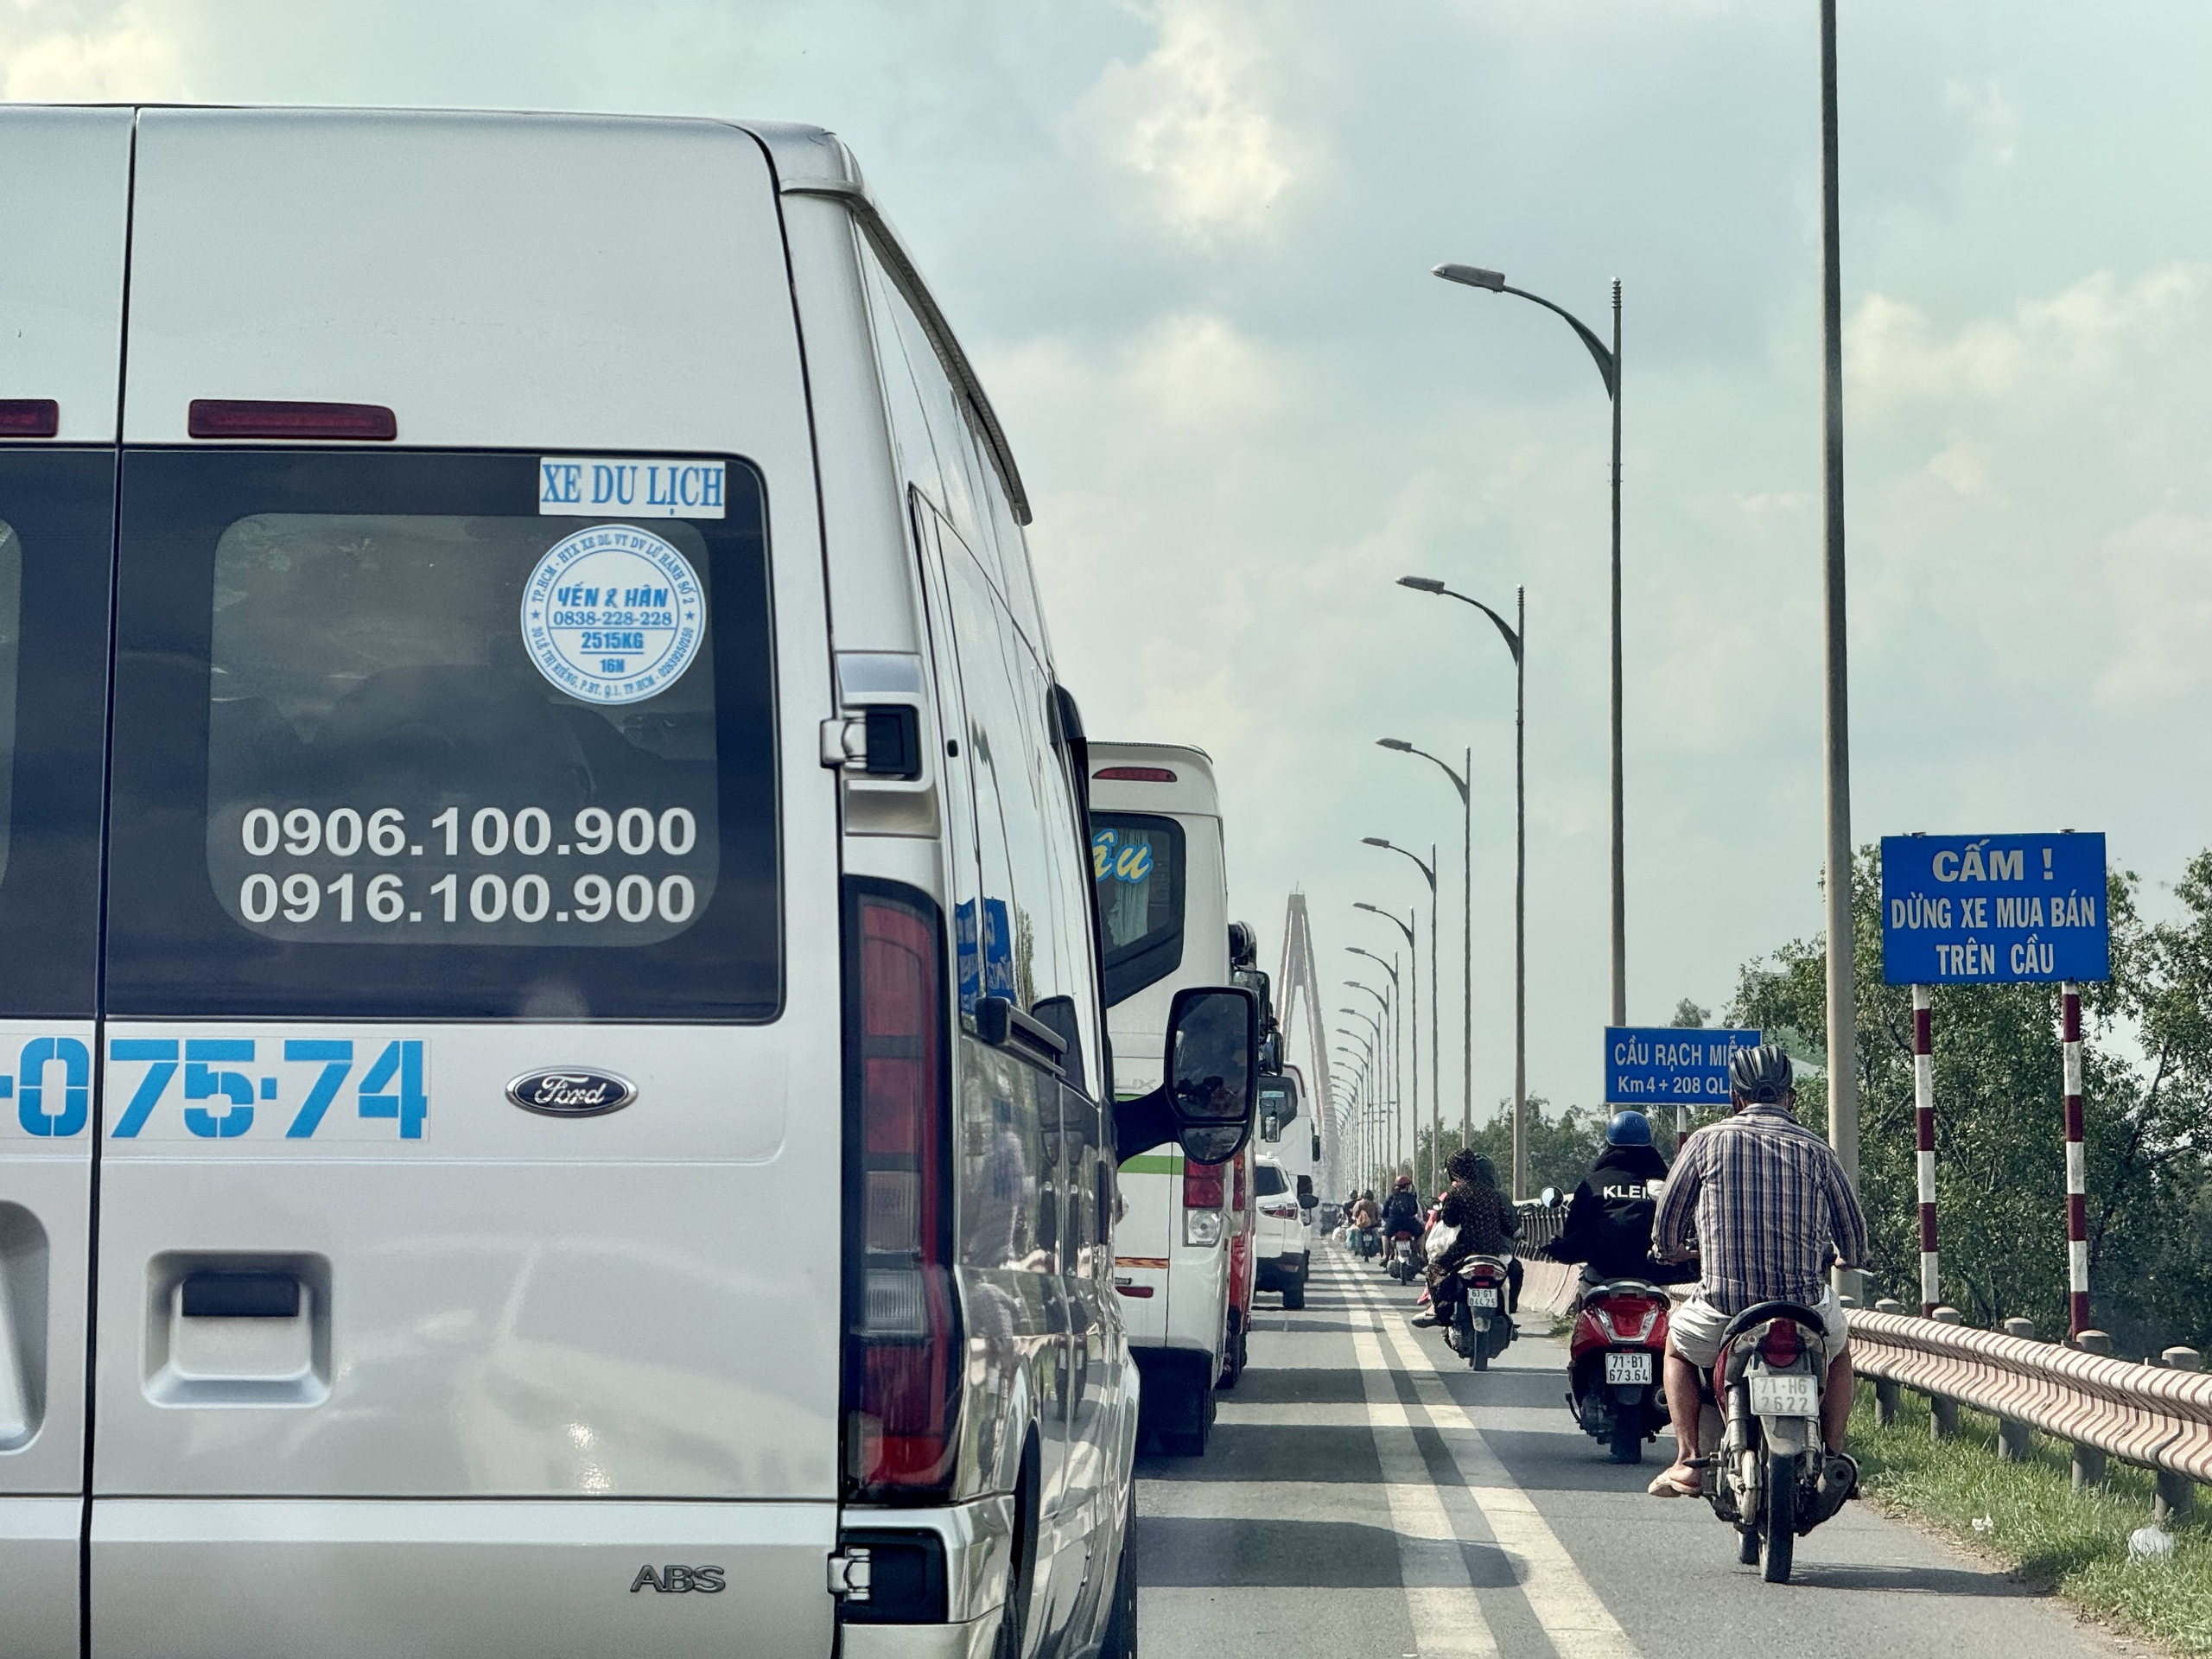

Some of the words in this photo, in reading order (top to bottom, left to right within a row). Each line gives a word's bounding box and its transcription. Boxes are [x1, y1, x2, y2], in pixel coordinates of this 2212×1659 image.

[541, 464, 582, 503] XE
[591, 465, 638, 505] DU
[646, 467, 723, 516] LỊCH
[531, 564, 557, 602] TP.HCM
[557, 543, 581, 563] HTX
[580, 537, 595, 550] XE
[614, 534, 629, 546] VT
[630, 537, 647, 550] DV
[658, 553, 685, 581] HÀNH
[677, 581, 696, 594] SỐ
[558, 582, 600, 607] YẾN
[604, 588, 618, 608] &
[625, 584, 668, 607] HÂN
[554, 611, 672, 626] 0838-228-228
[582, 632, 644, 649] 2515KG
[241, 807, 696, 856] 0906.100.900
[1932, 839, 2024, 882] CẤM
[2042, 848, 2054, 880] !
[239, 874, 696, 923] 0916.100.900
[1891, 891, 1952, 929] DỪNG
[1961, 897, 1987, 928] XE
[1996, 897, 2044, 928] MUA
[2050, 889, 2095, 927] BÁN
[1936, 937, 1995, 976] TRÊN
[2011, 933, 2054, 975] CẦU
[1614, 1034, 1649, 1065] CẦU
[1655, 1042, 1702, 1071] RẠCH
[534, 1075, 607, 1105] Ford
[1673, 1077, 1701, 1094] 208
[1706, 1077, 1730, 1094] QL
[1603, 1185, 1649, 1200] KLEI
[1609, 1369, 1648, 1382] 673.64
[1761, 1396, 1808, 1413] 2622
[630, 1565, 726, 1593] ABS
